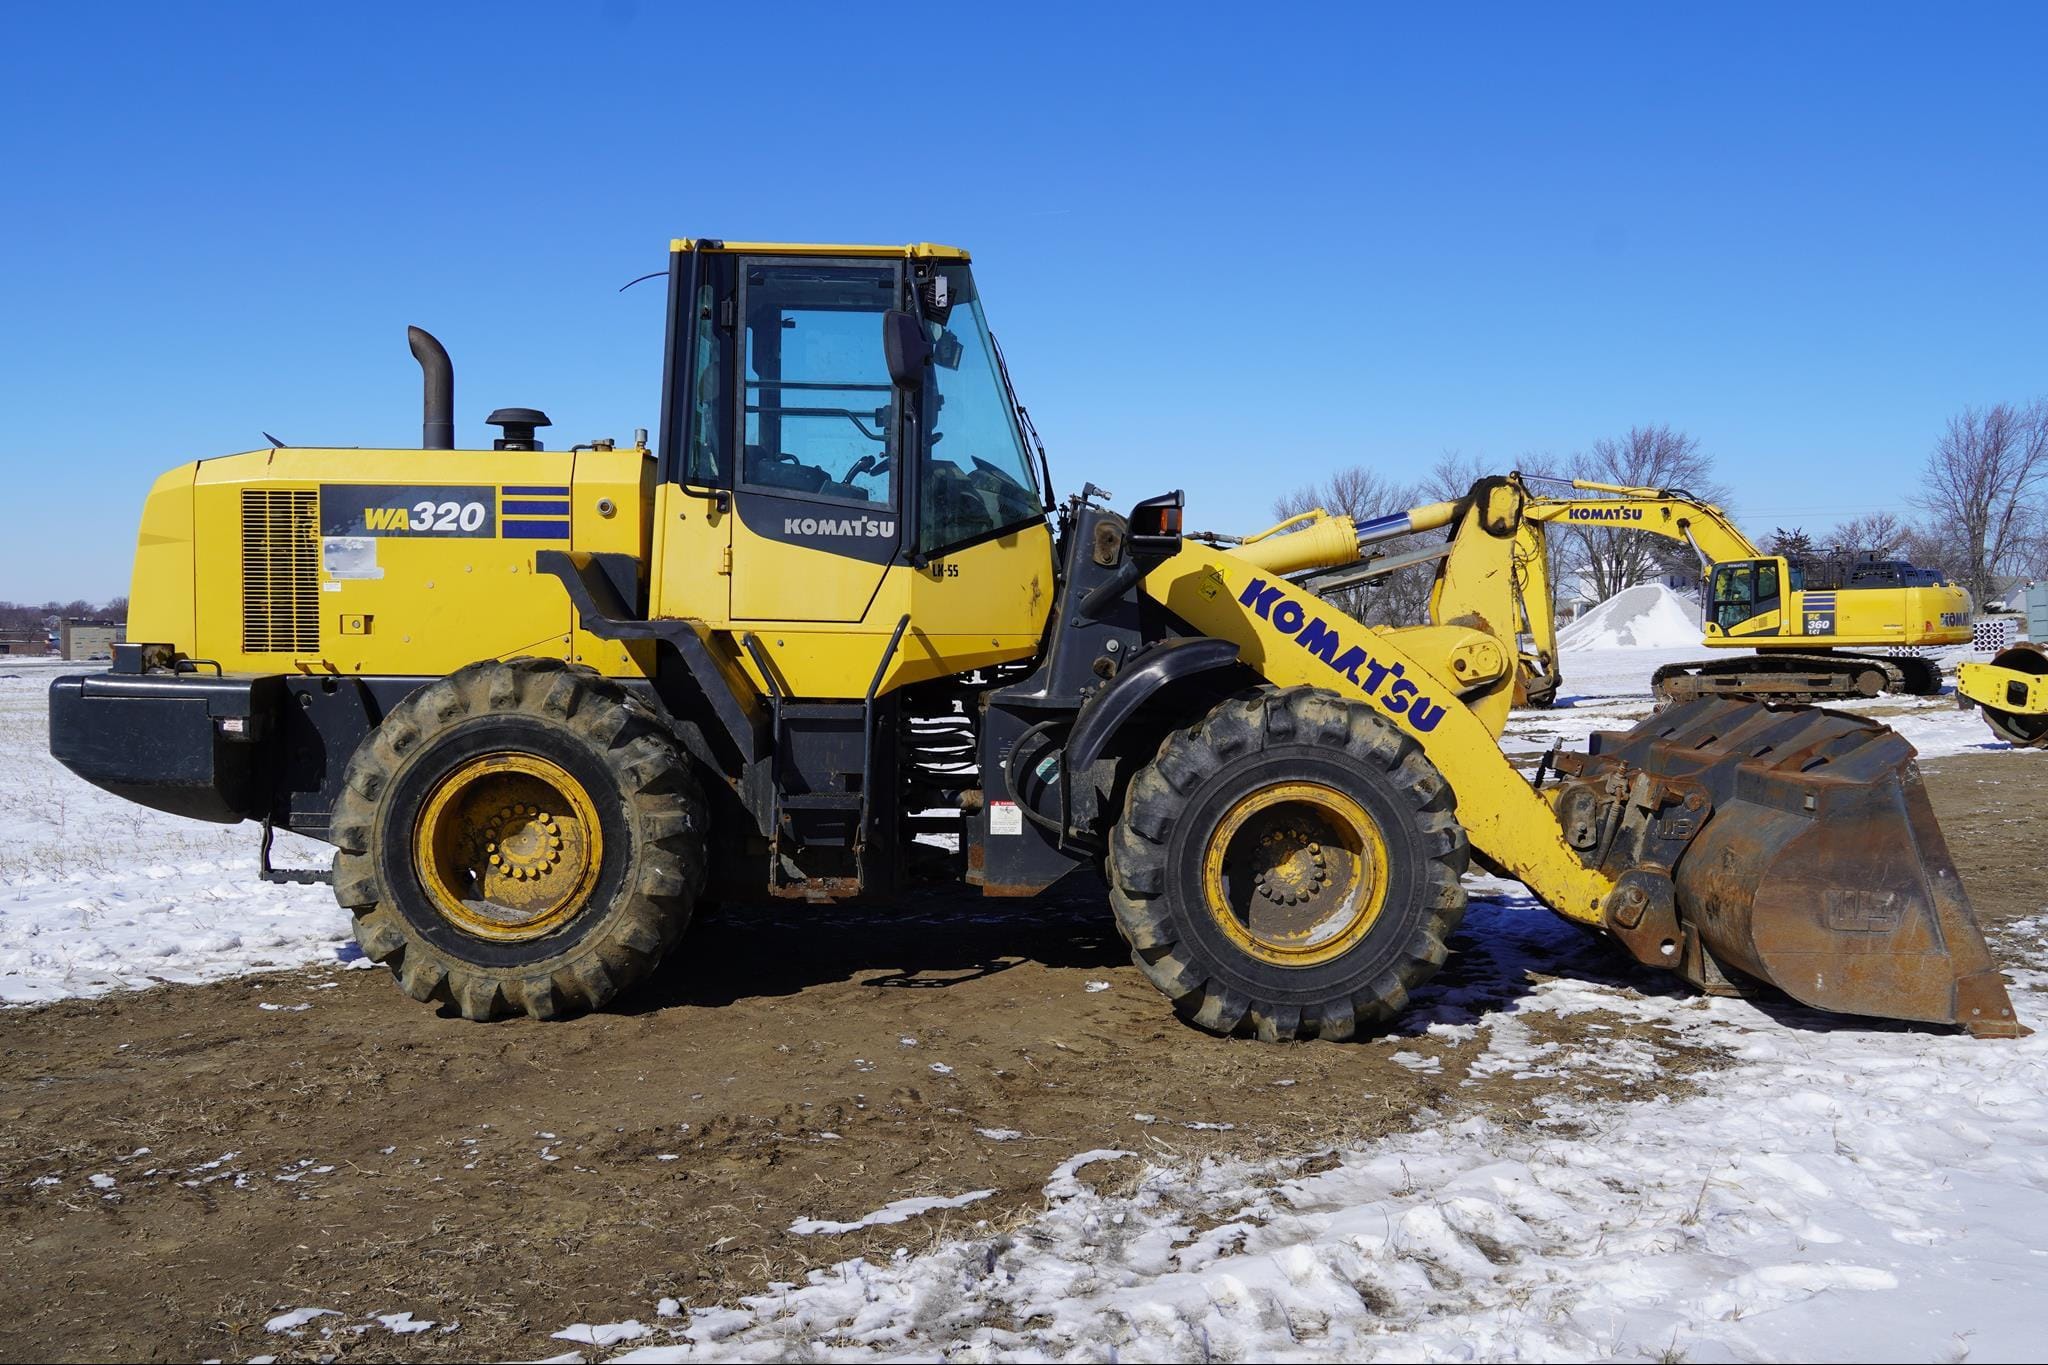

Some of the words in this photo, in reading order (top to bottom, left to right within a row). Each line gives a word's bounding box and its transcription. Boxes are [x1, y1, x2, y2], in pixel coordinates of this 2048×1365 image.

[364, 501, 486, 532] WA320
[1568, 505, 1643, 521] KOMATSU
[784, 515, 895, 538] KOMATSU
[1807, 620, 1830, 629] 360
[1238, 577, 1447, 732] KOMATSU
